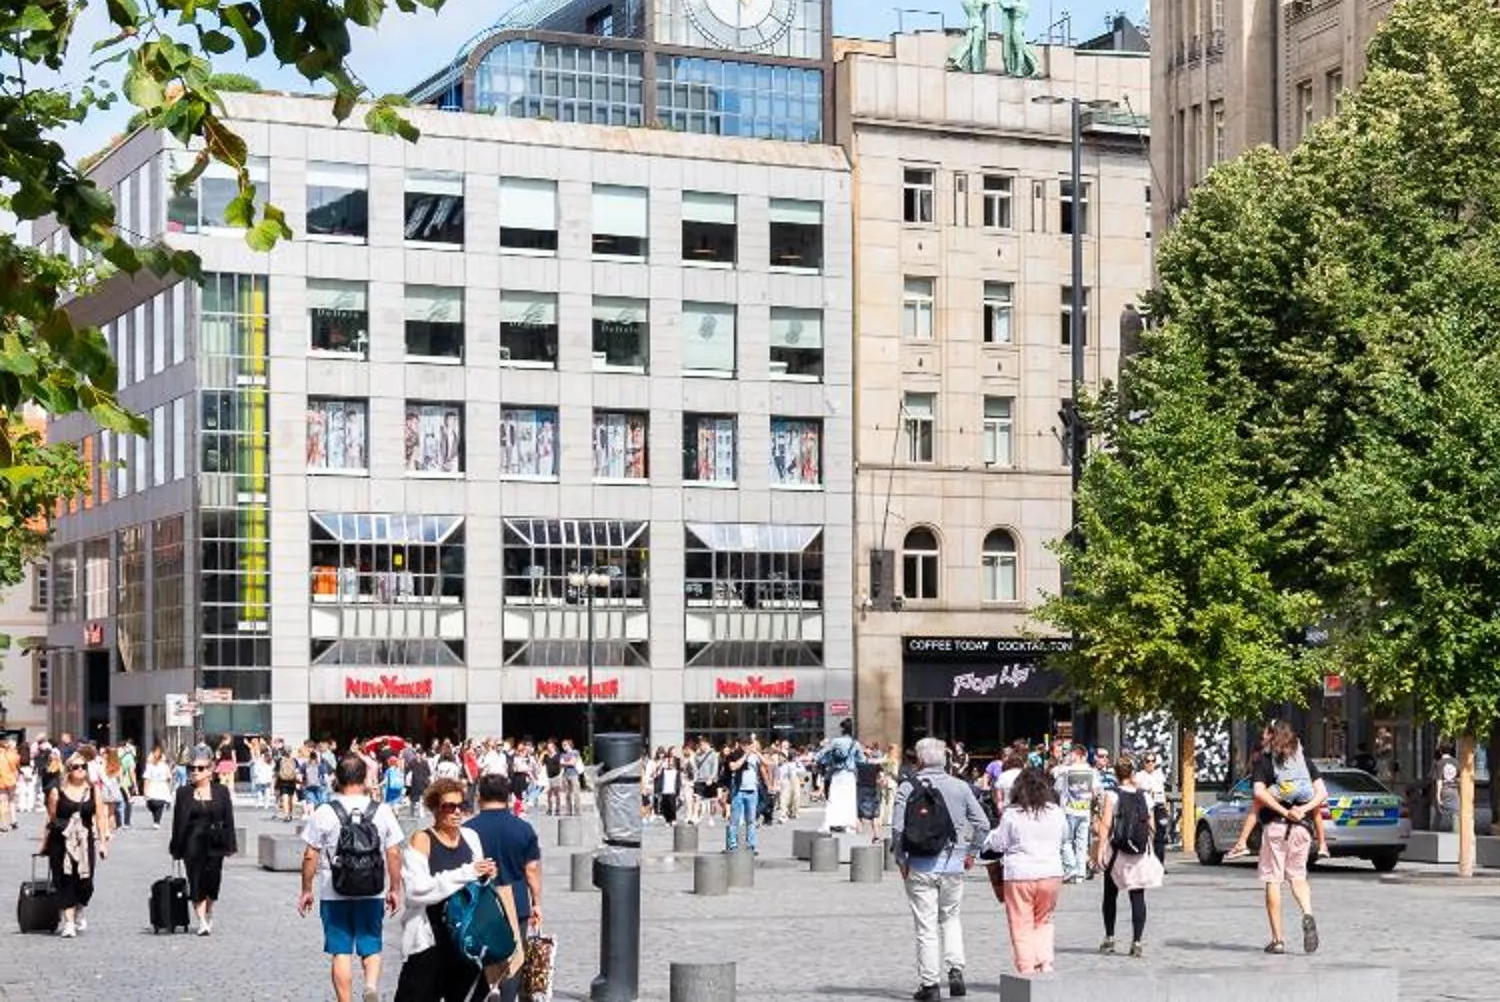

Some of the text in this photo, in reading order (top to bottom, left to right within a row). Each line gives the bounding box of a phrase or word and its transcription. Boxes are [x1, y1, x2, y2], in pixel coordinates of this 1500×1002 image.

[910, 639, 953, 651] COFFEE
[954, 639, 989, 651] TODAY
[1050, 641, 1073, 652] TON
